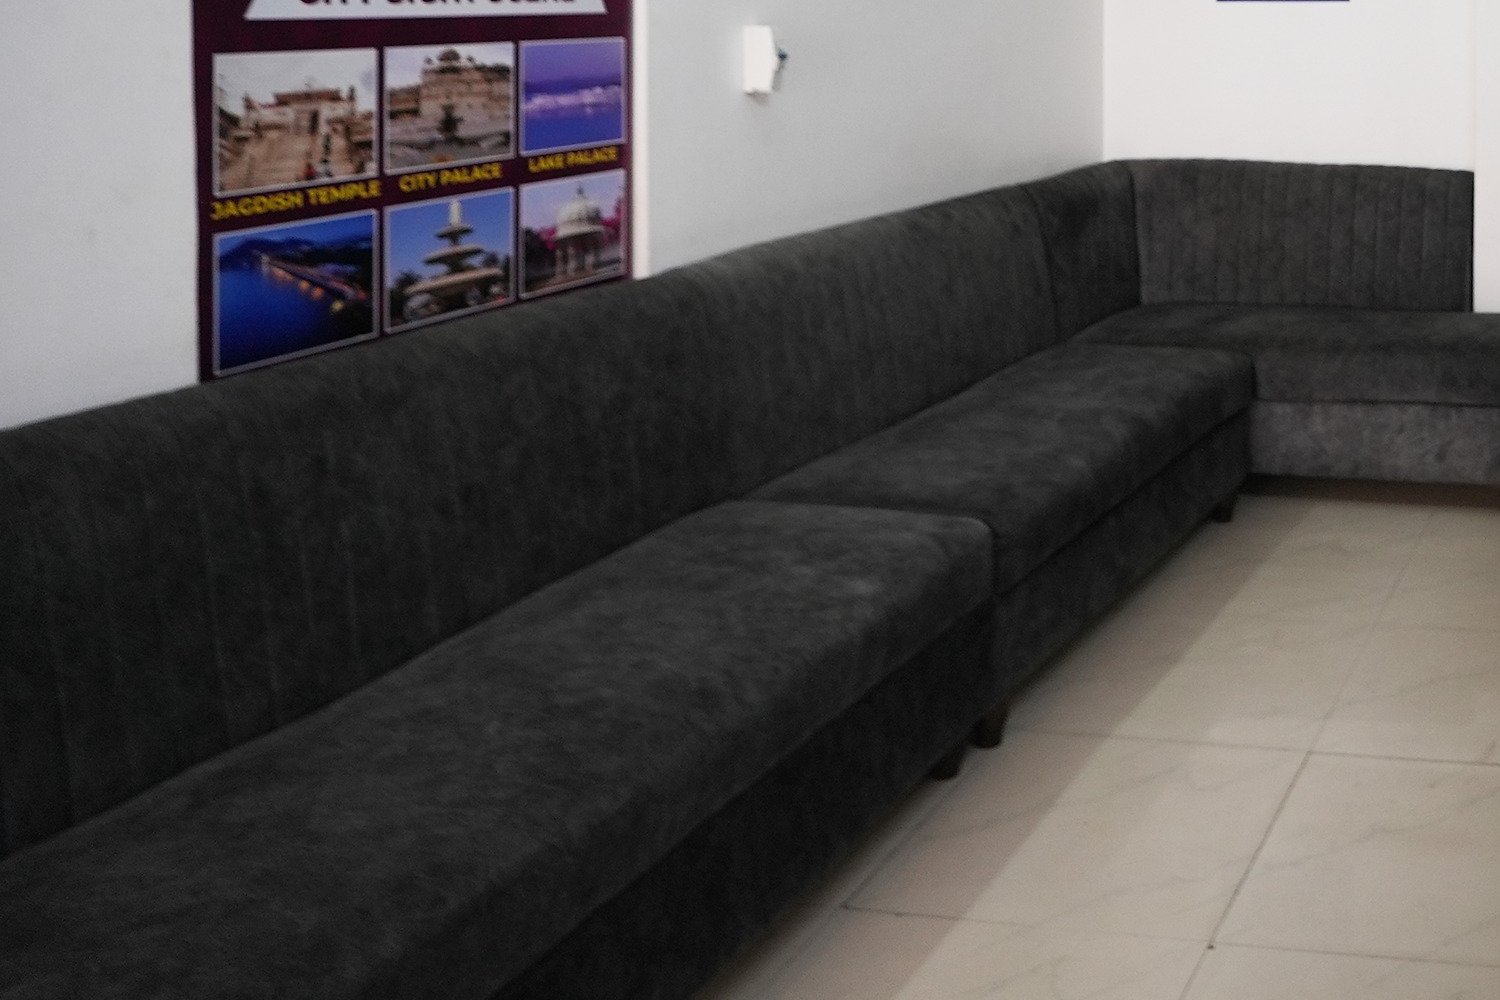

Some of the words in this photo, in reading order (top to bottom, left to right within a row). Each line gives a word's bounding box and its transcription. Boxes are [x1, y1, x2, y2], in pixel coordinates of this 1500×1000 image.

[528, 152, 564, 173] LAKE
[565, 145, 619, 167] PALACE
[399, 170, 437, 193] CITY
[439, 161, 503, 185] PALACE
[210, 191, 304, 220] JAGDISH
[306, 178, 382, 205] TEMPLE
